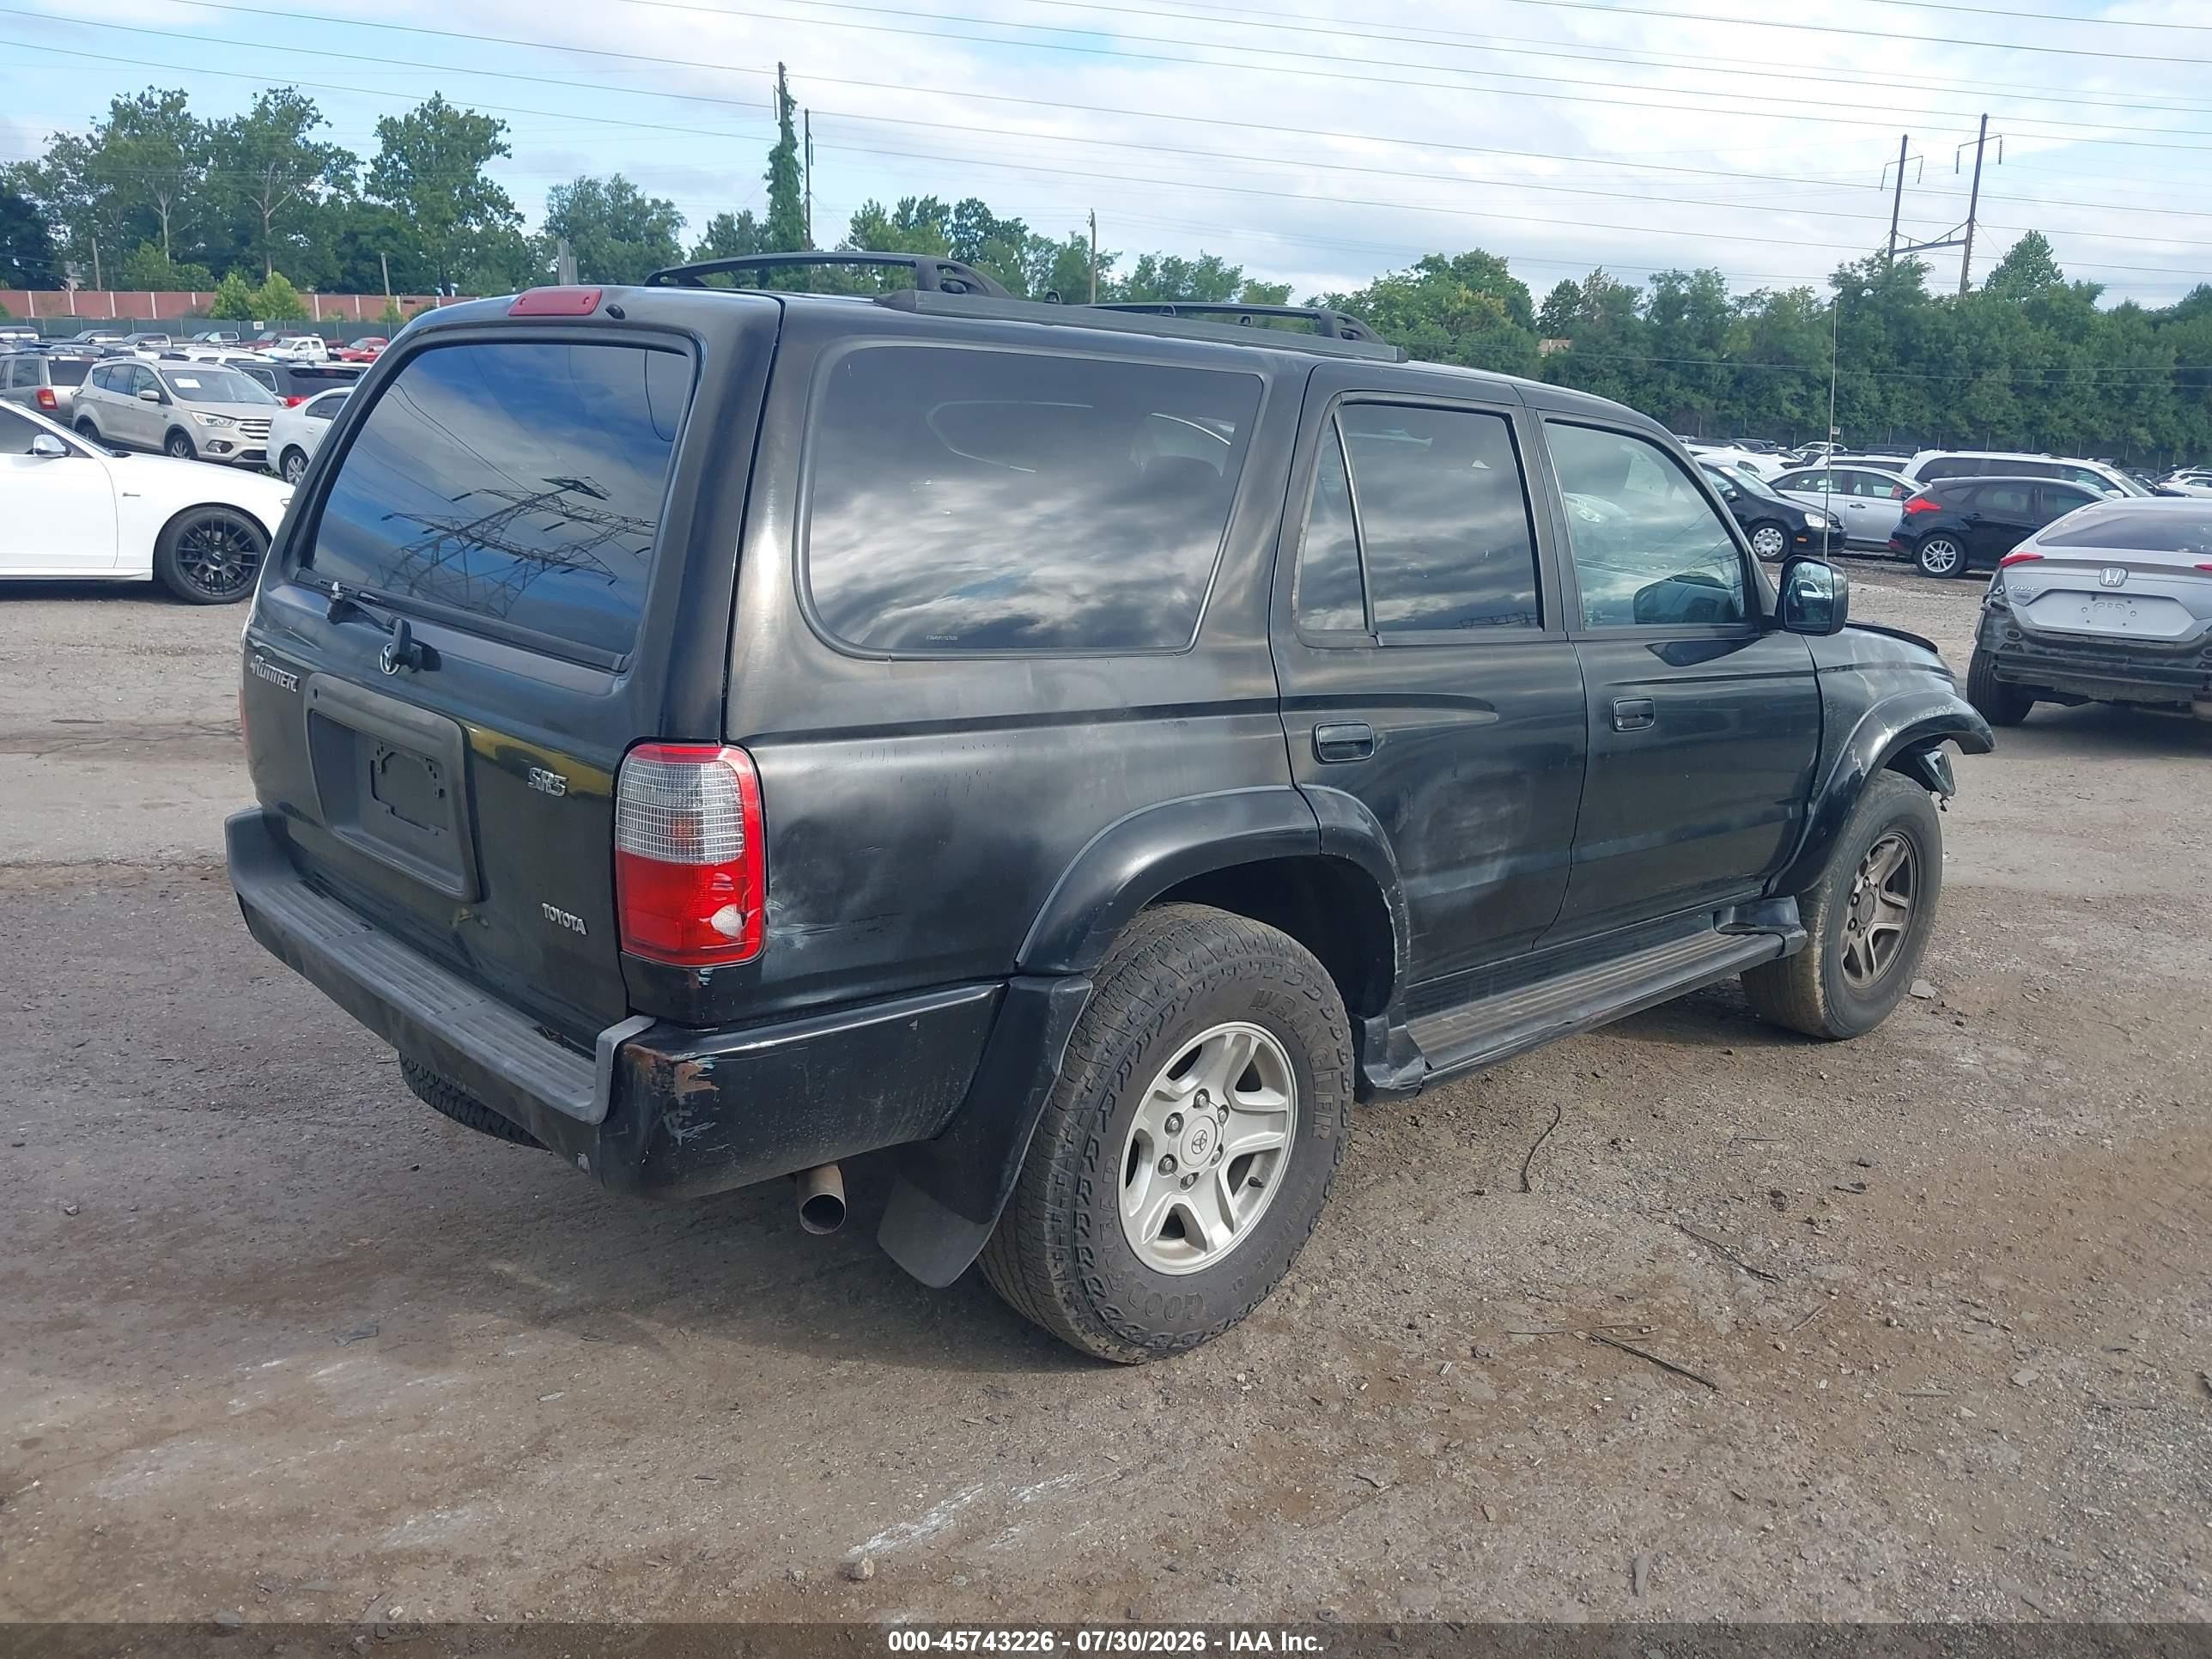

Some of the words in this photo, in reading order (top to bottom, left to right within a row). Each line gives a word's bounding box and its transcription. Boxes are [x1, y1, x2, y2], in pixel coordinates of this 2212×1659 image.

[527, 767, 568, 797] SR5
[542, 902, 587, 935] TOYOTA
[1248, 988, 1334, 1140] WRANGLER
